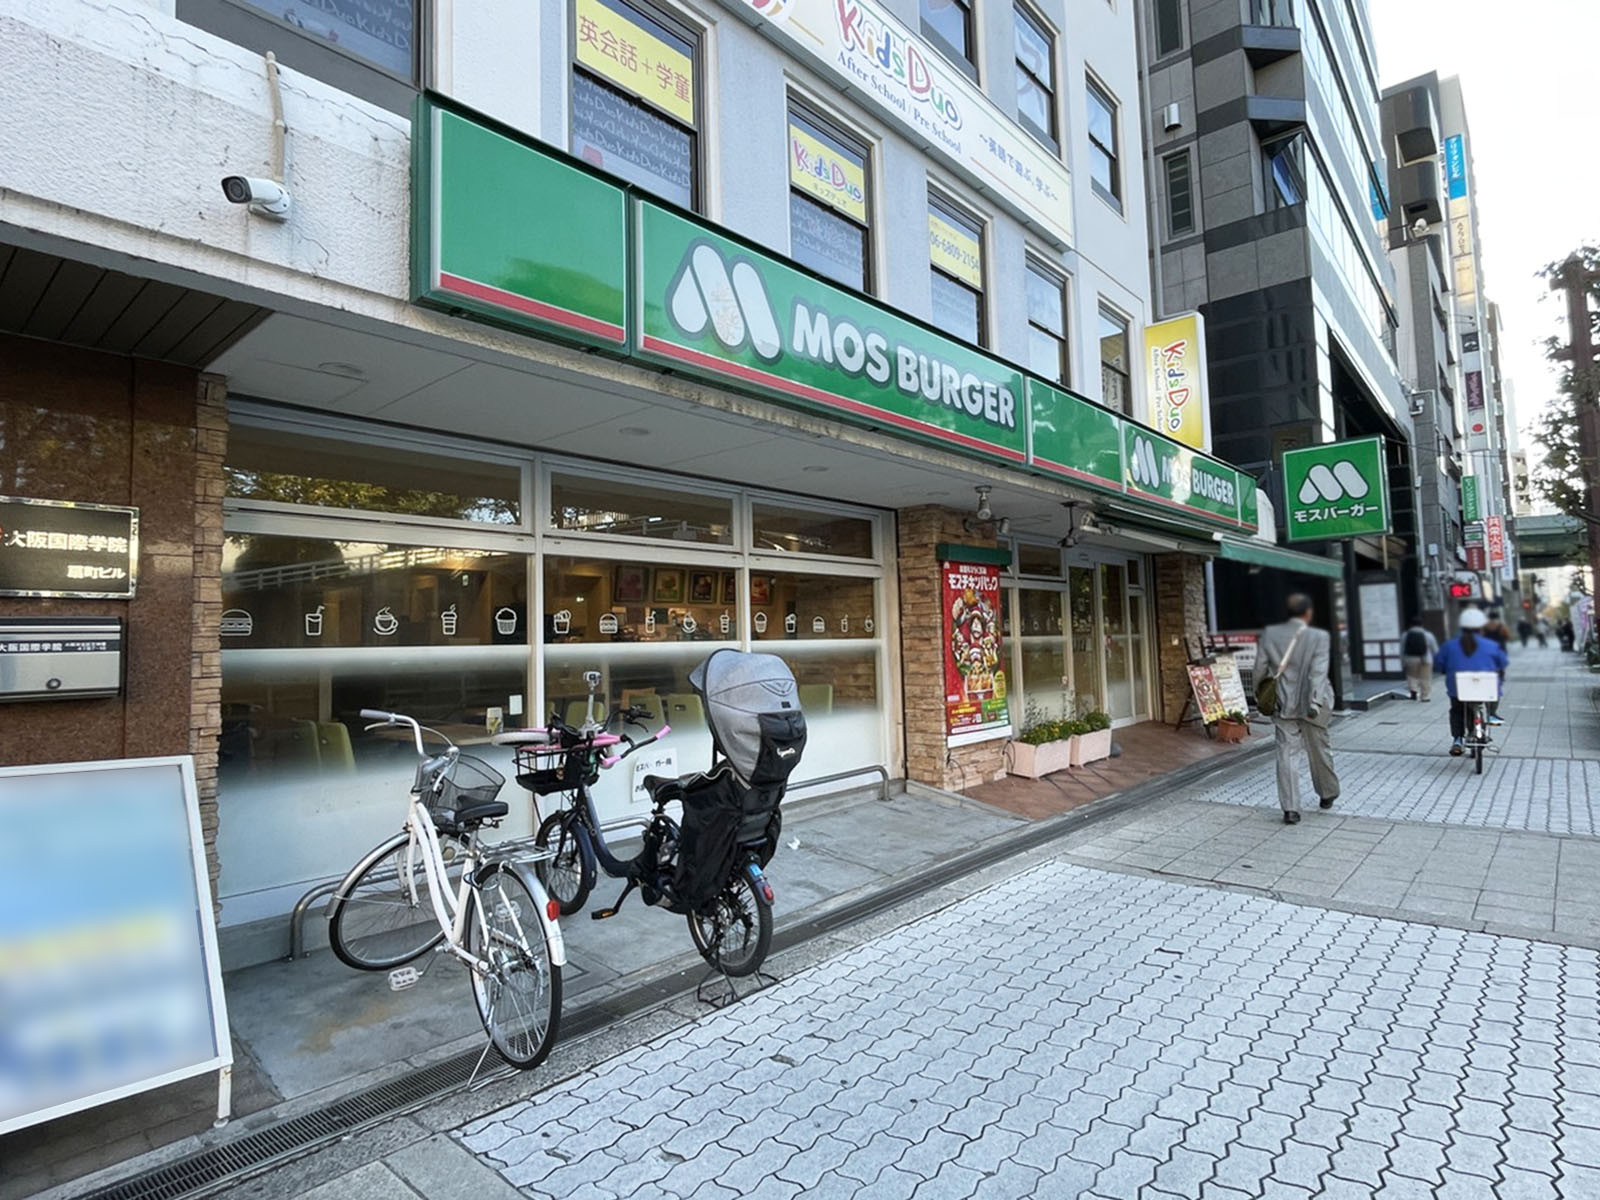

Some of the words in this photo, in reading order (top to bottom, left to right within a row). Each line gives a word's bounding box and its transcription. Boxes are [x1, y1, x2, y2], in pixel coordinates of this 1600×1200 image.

[579, 15, 690, 104] 英会話+学童
[838, 0, 959, 123] KidsDuo
[838, 51, 869, 80] After
[870, 75, 906, 113] School
[913, 107, 932, 130] Pre
[932, 124, 962, 154] School
[794, 140, 862, 200] KidsDuo
[792, 303, 891, 383] MOS
[897, 346, 1015, 428] BURGER
[1164, 341, 1190, 430] KidsDuo
[1192, 467, 1235, 506] BURGER
[1294, 503, 1379, 523] モスバーガー
[10, 530, 128, 553] 大阪国際学院
